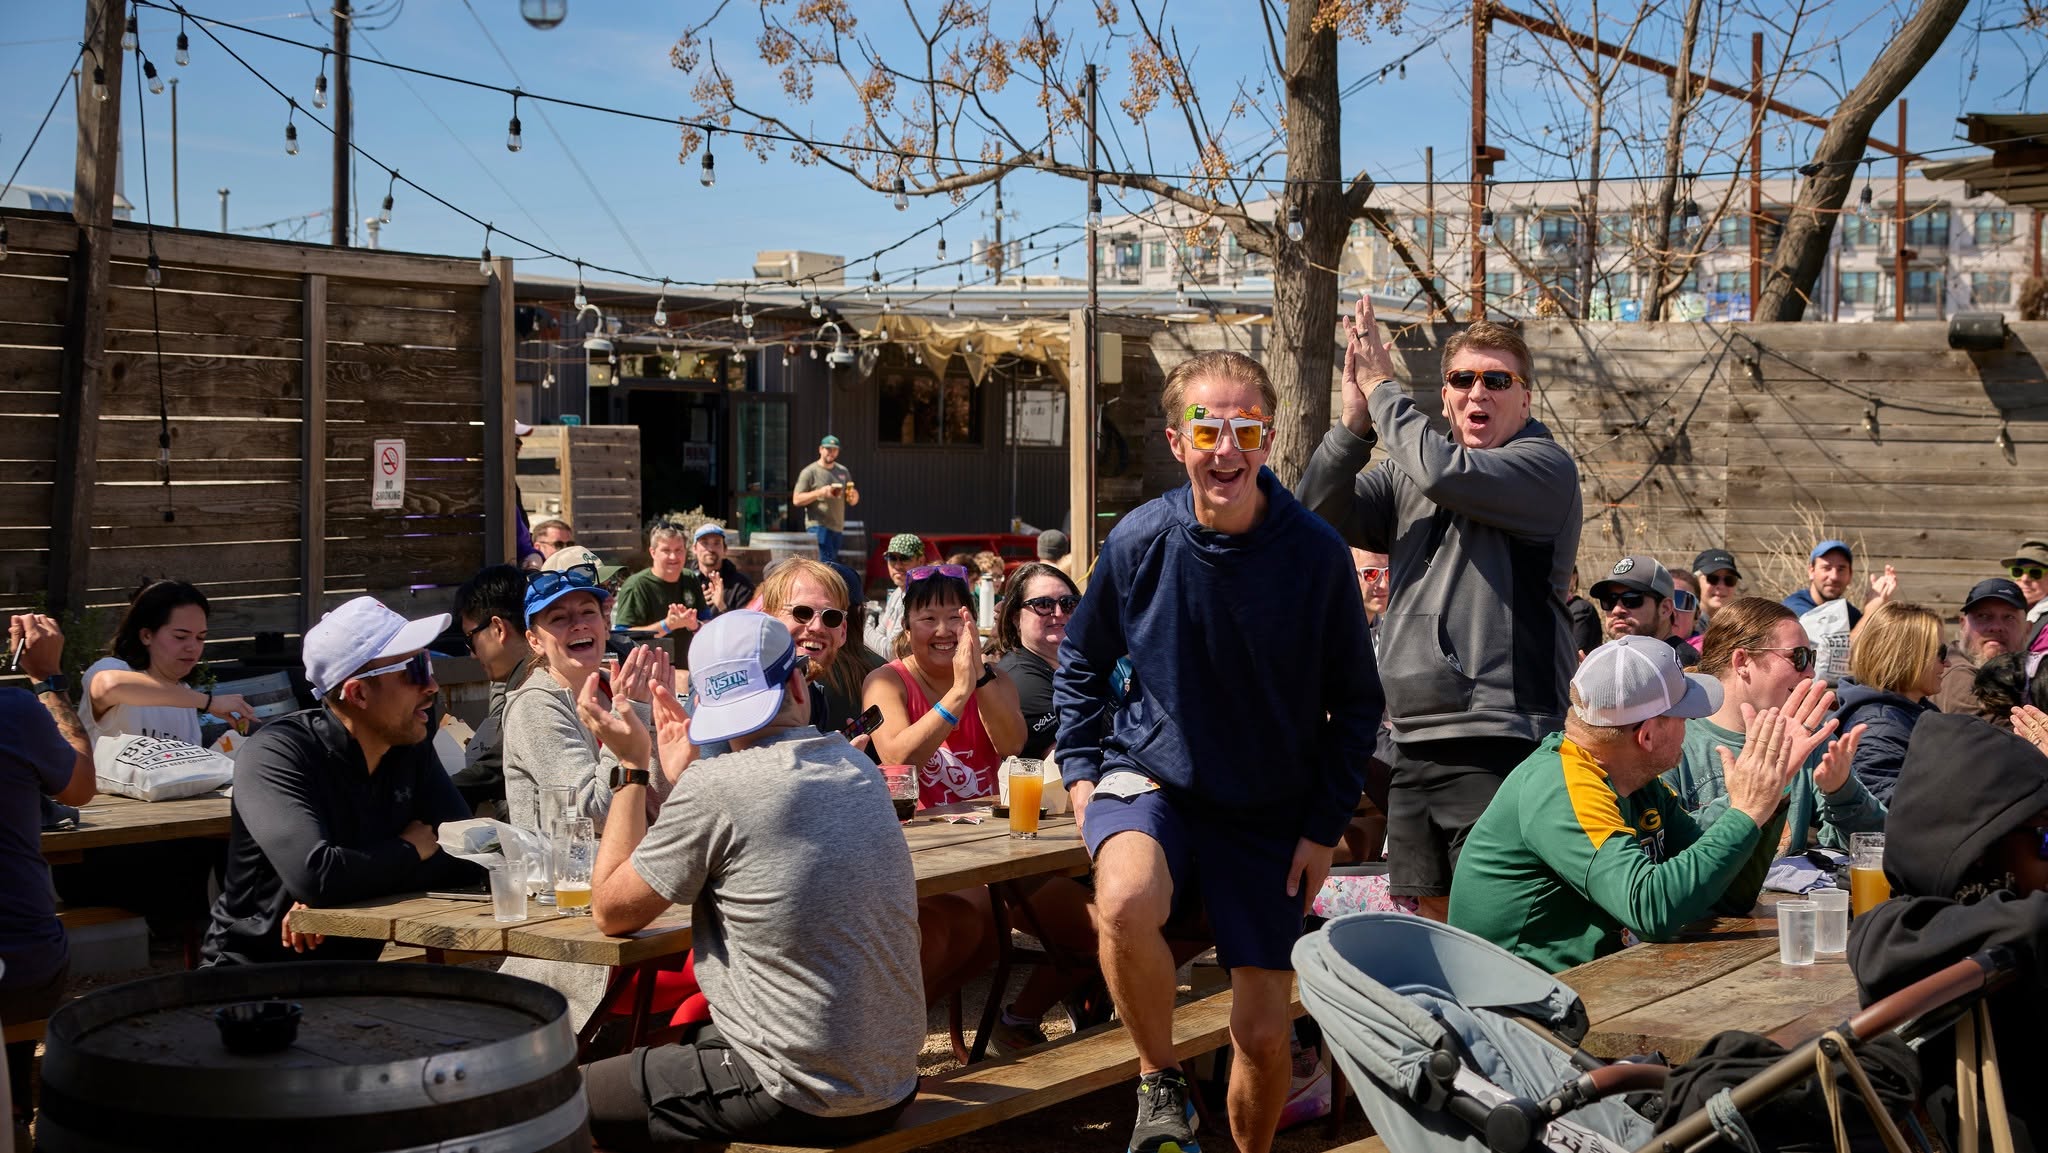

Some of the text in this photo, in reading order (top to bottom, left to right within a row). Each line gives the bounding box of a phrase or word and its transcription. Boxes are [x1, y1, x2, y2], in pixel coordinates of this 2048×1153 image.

[385, 480, 393, 489] NO
[376, 490, 400, 500] SMOKING
[705, 670, 748, 700] AUSTIN
[1032, 712, 1056, 731] DELL
[1640, 808, 1661, 831] G
